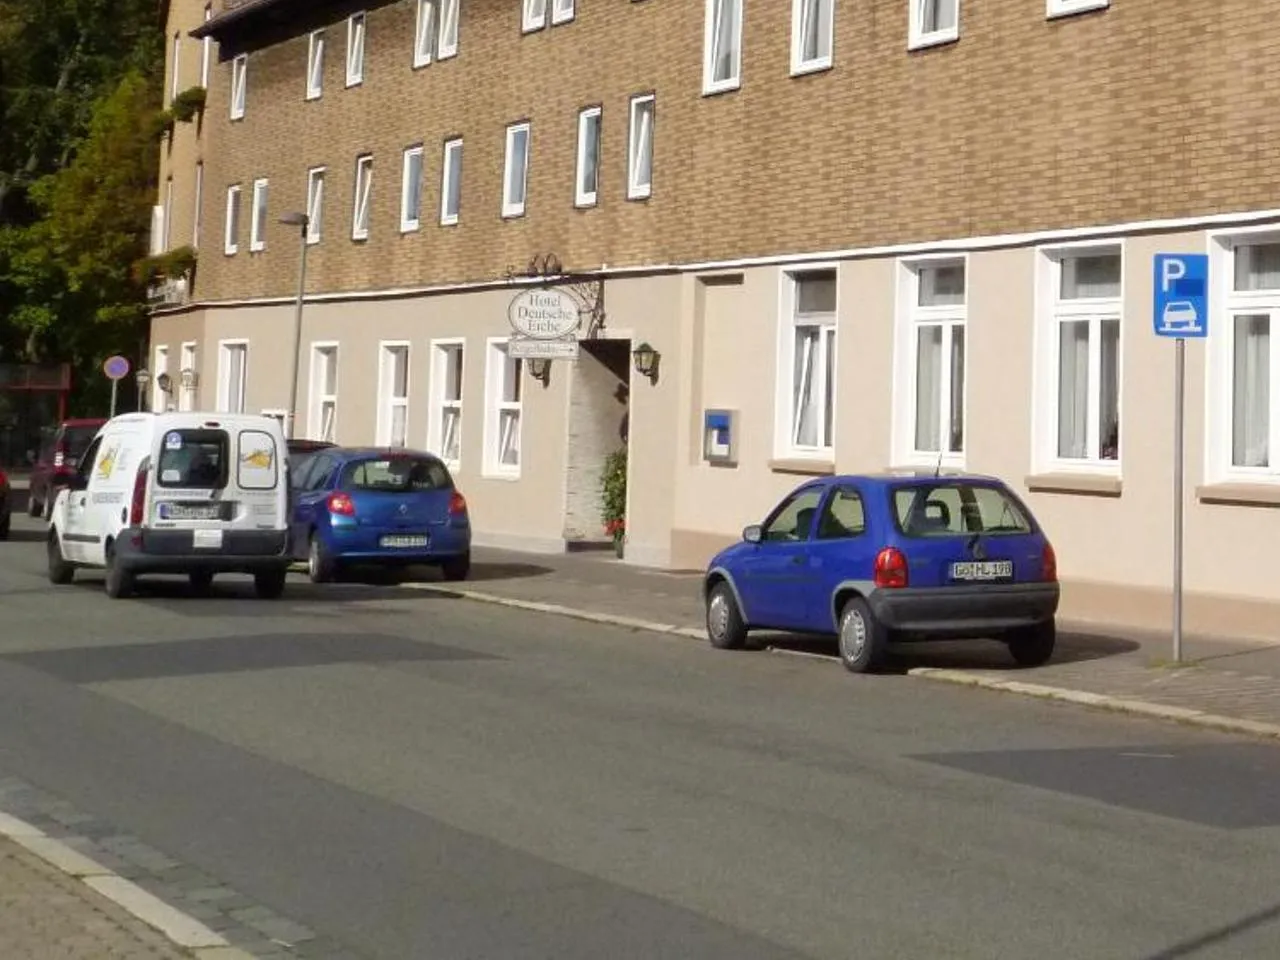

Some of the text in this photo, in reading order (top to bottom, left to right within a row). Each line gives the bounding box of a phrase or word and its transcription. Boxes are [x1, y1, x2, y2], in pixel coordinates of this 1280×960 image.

[1162, 258, 1186, 292] P
[530, 294, 561, 306] Hotel
[518, 307, 573, 320] Deutsche
[528, 319, 562, 332] Eiche
